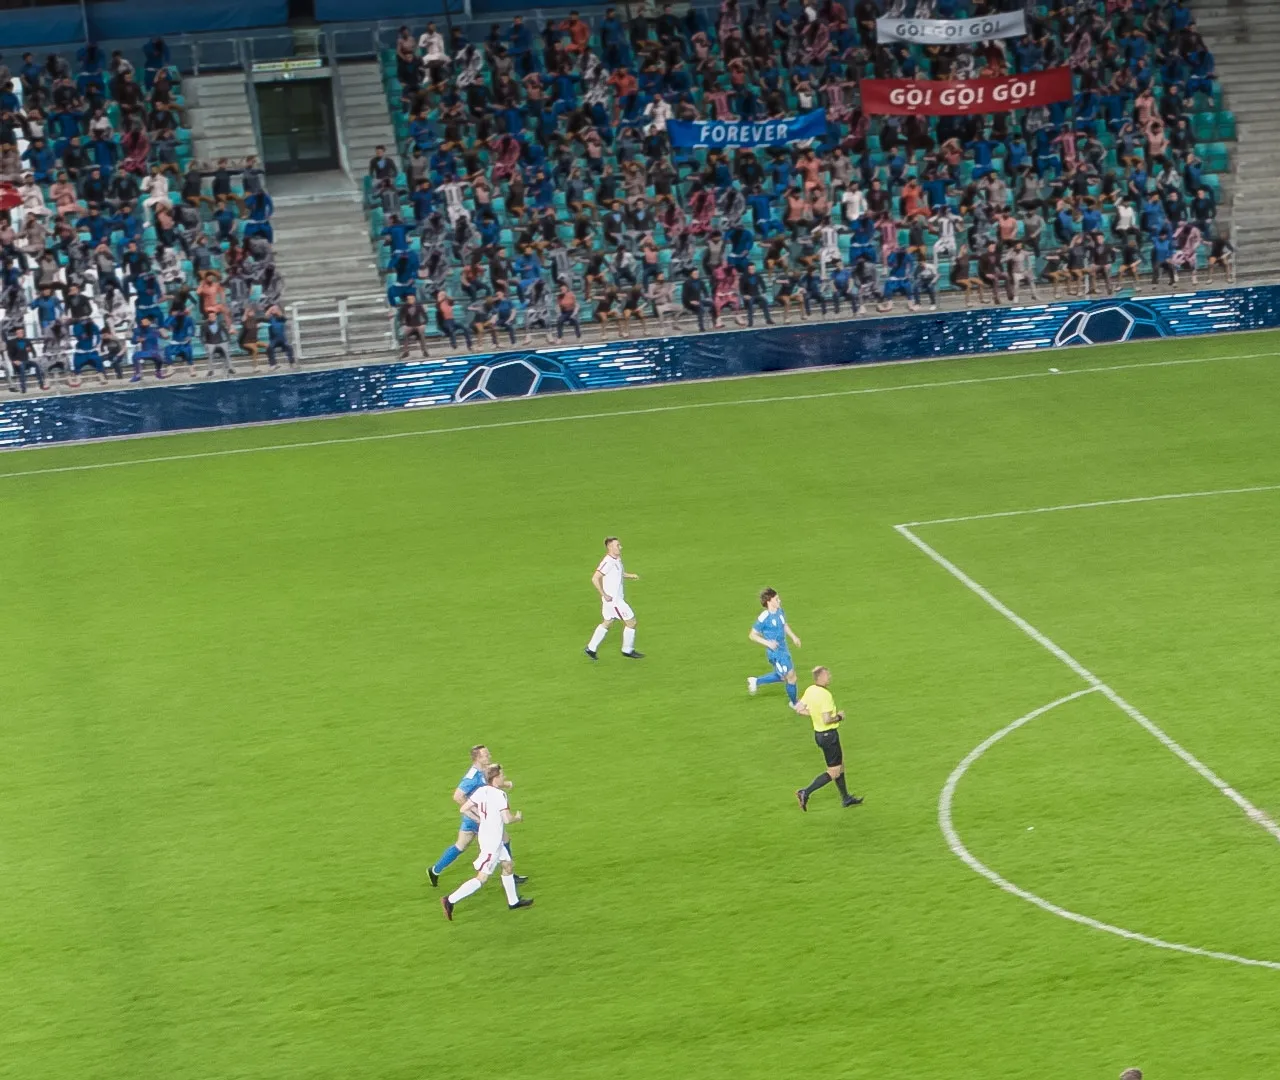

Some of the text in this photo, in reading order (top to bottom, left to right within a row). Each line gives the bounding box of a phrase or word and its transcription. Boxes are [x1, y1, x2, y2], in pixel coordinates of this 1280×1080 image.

[889, 80, 1036, 108] GO! GO! GO!
[700, 124, 788, 143] FOREVER
[480, 801, 488, 820] 4
